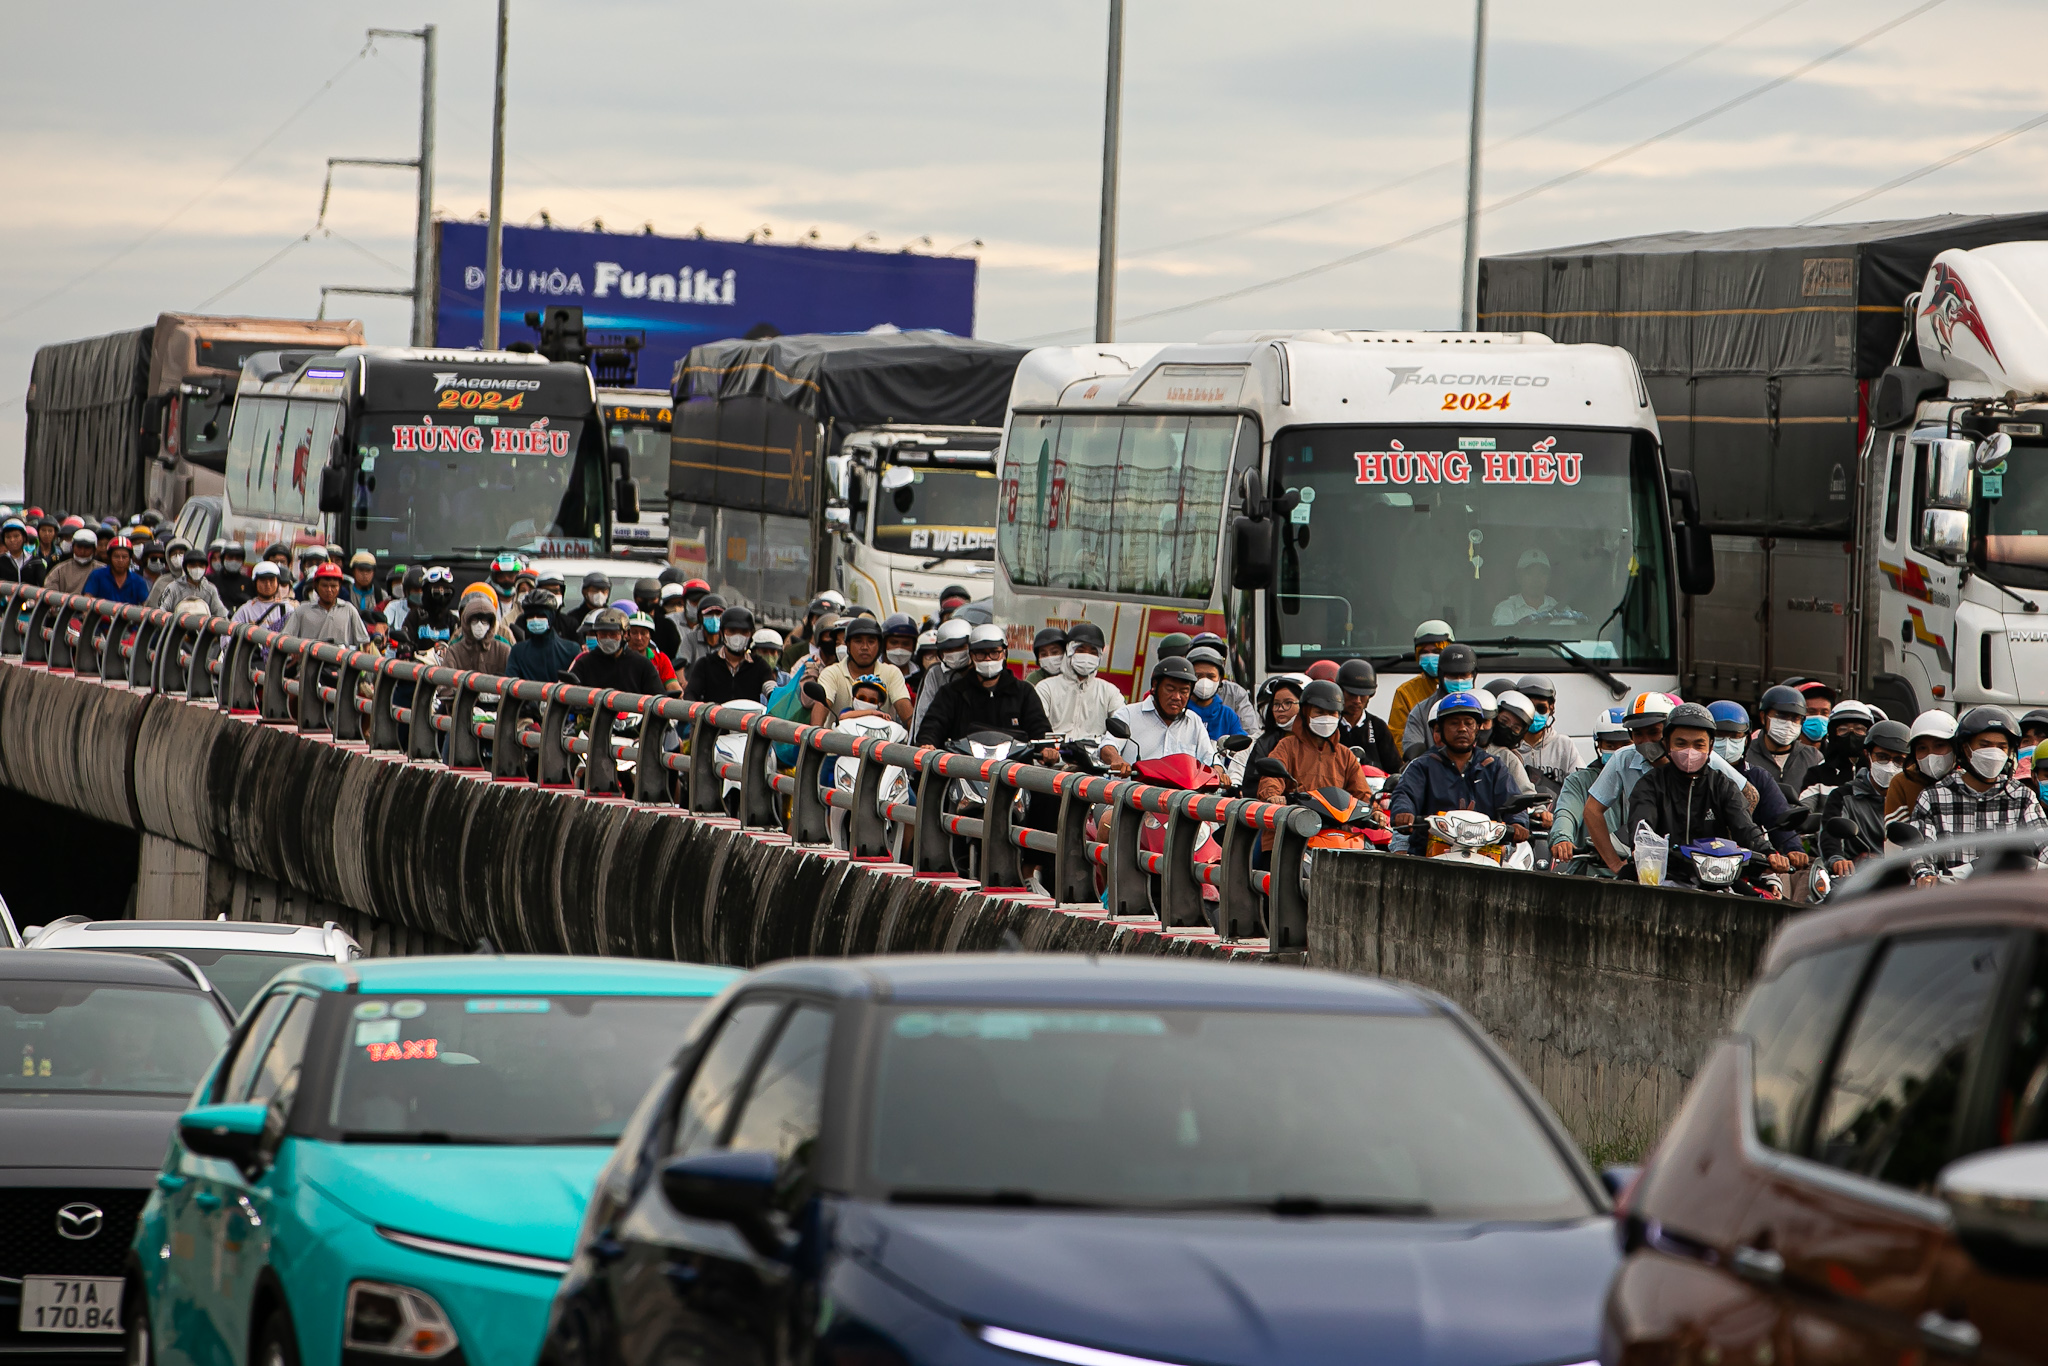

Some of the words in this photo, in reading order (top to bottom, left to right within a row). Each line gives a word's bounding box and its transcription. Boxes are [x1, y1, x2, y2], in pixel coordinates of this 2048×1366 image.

[528, 267, 585, 296] HÒA
[593, 261, 737, 306] Funiki
[432, 372, 541, 393] TRACOMECO
[1386, 366, 1550, 395] TRACOMECO
[437, 389, 525, 411] 2024
[1441, 391, 1512, 411] 2024
[392, 415, 484, 453] HÙNG
[491, 416, 570, 457] HIẾU
[1354, 439, 1472, 484] HÙNG
[1481, 436, 1583, 486] HIẾU
[366, 1038, 438, 1062] TAXI
[54, 1282, 98, 1304] 71A
[36, 1306, 115, 1329] 170.84
